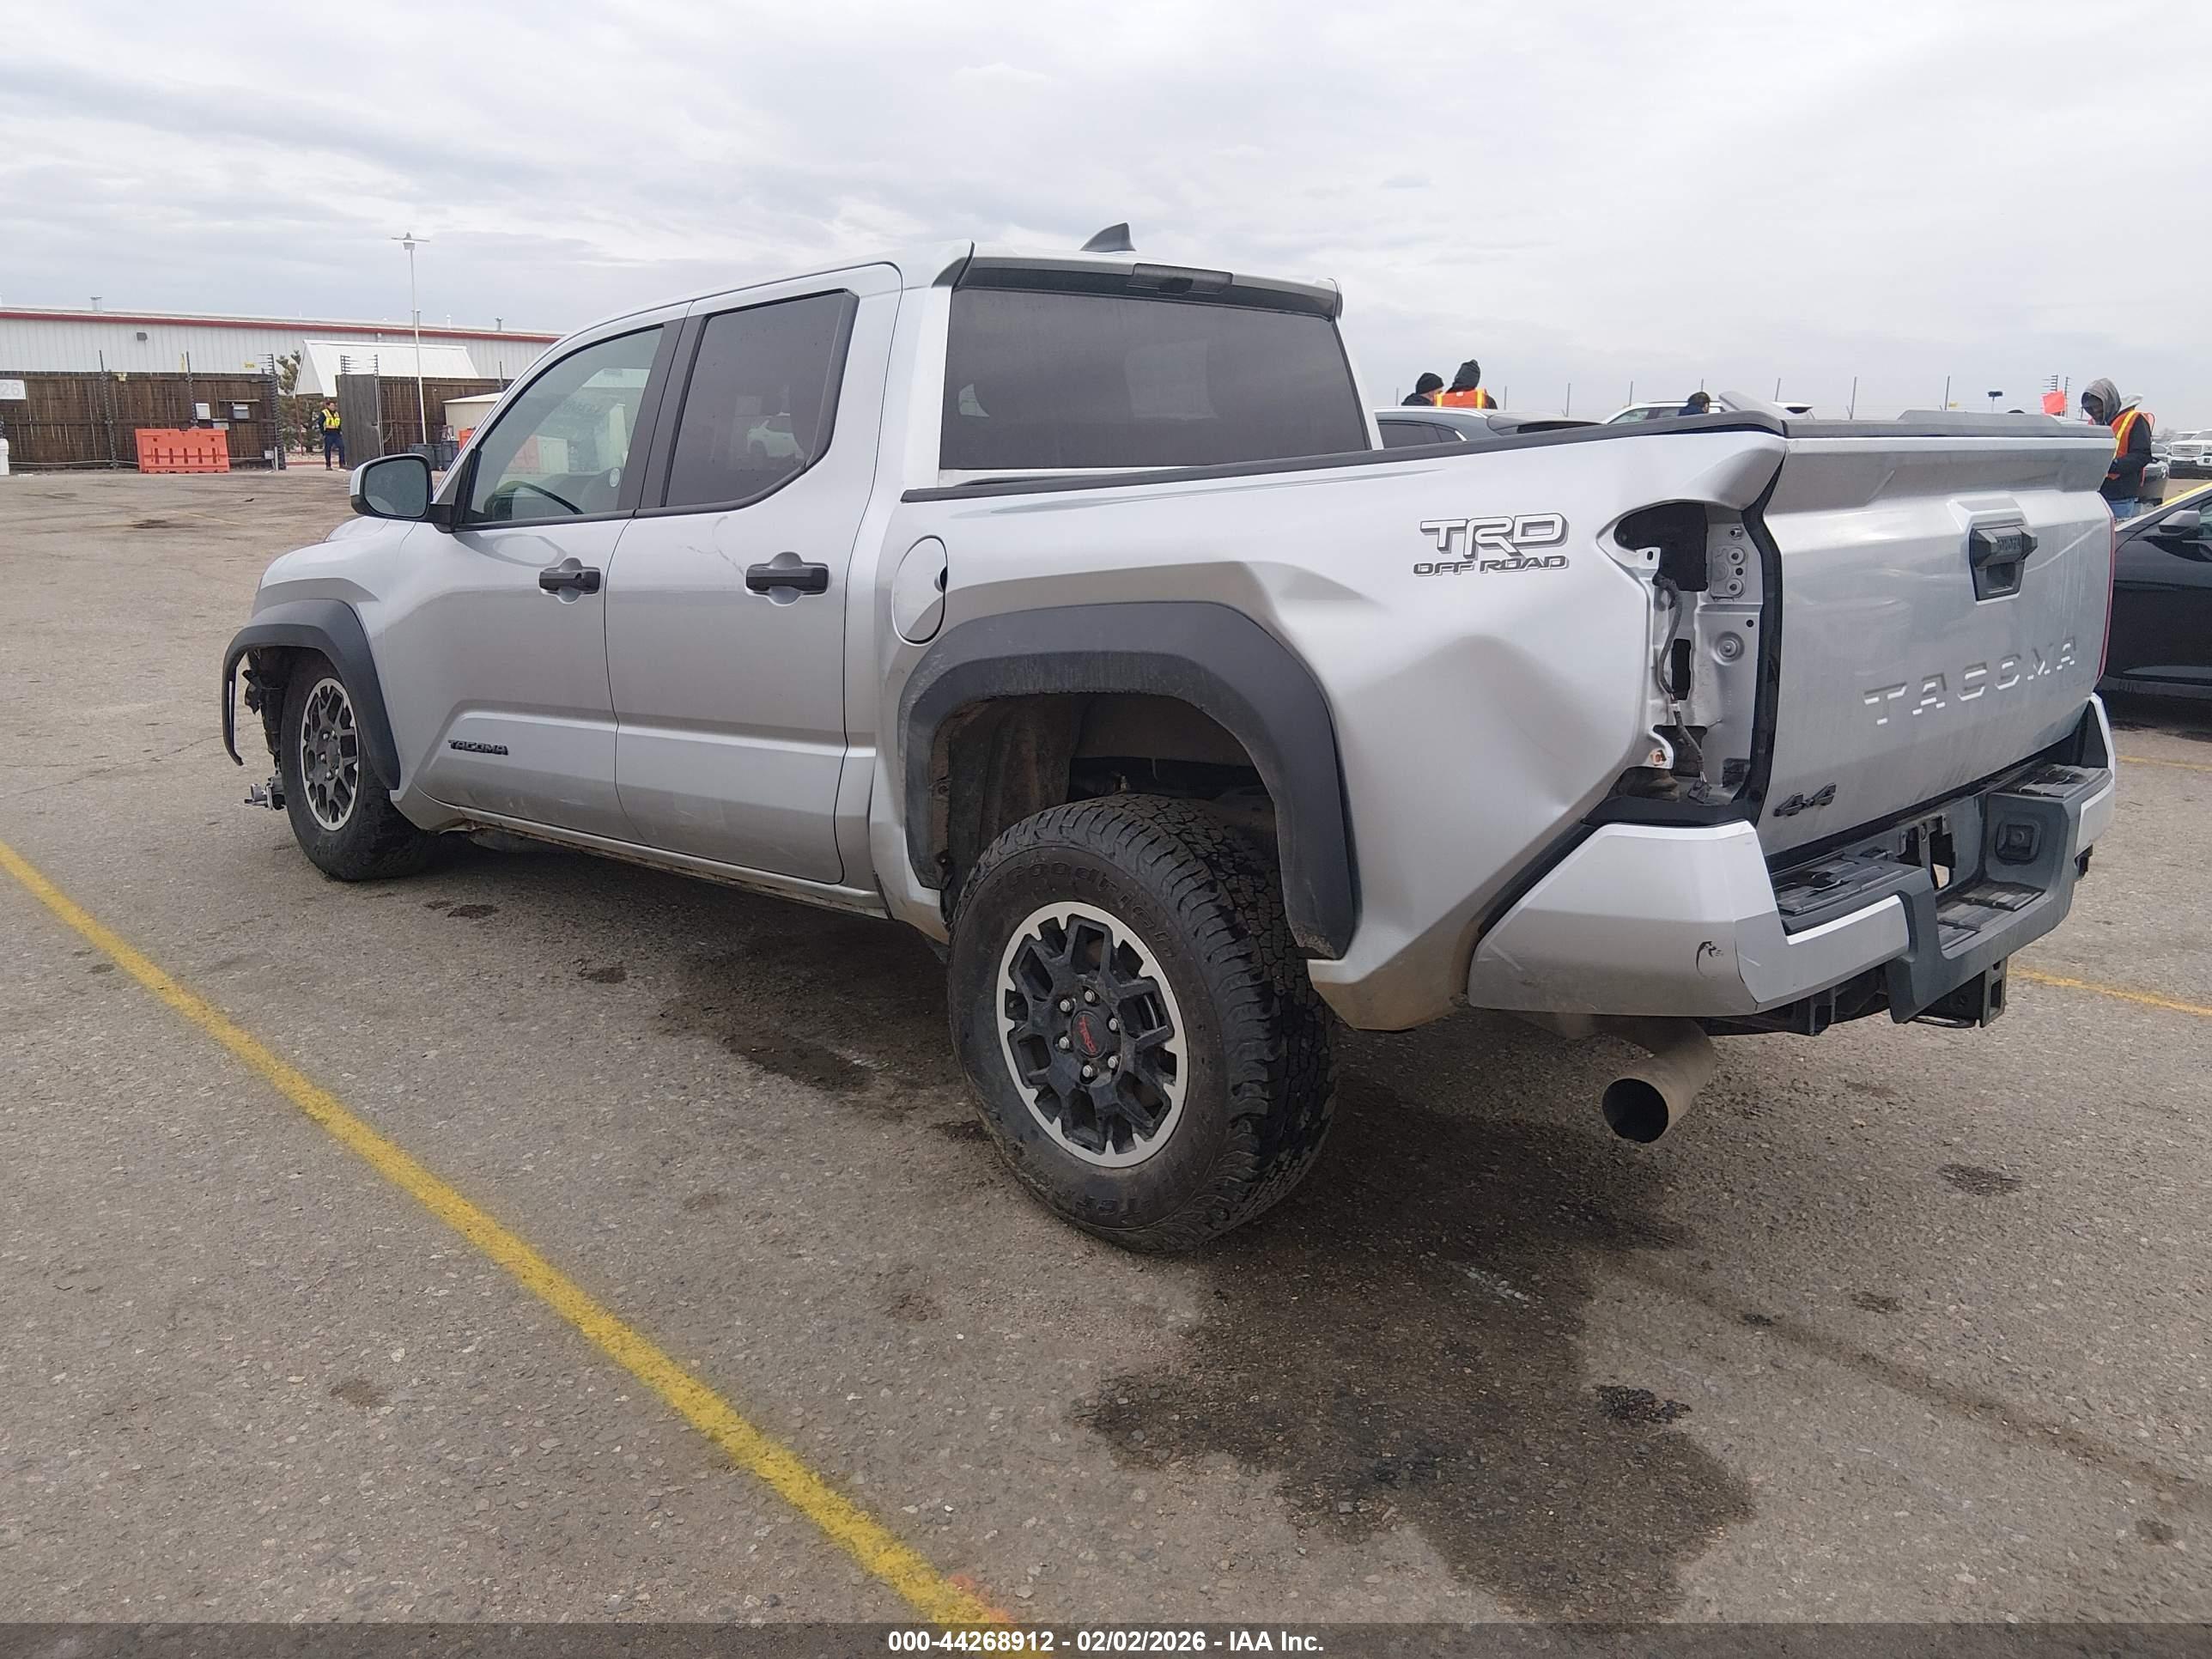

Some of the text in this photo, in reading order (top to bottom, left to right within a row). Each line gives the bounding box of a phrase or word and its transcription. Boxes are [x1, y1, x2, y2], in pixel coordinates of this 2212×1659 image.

[1419, 513, 1569, 562] TRD
[1413, 556, 1570, 577] OFF ROAD
[1863, 635, 2076, 726] TACOMA
[447, 739, 509, 756] TACOMA
